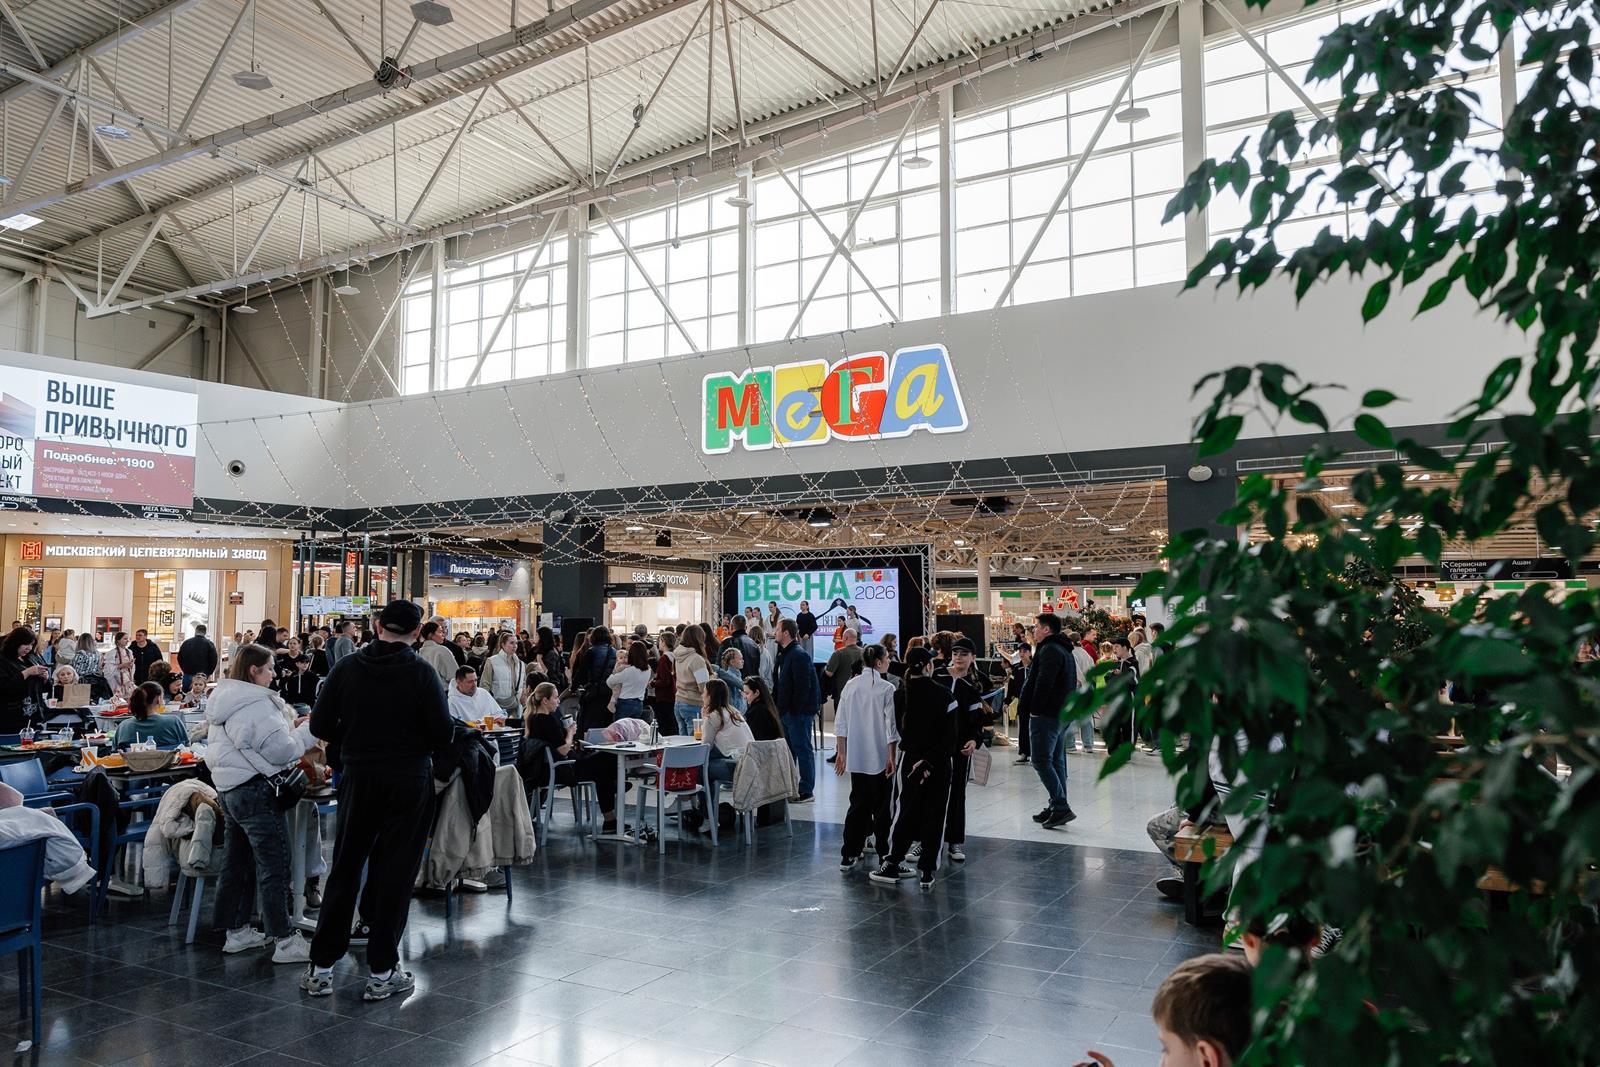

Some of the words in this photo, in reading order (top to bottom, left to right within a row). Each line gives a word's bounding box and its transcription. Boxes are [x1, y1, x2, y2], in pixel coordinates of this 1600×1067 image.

[47, 379, 115, 411] ВЫШЕ
[45, 410, 188, 449] ПРИВЫЧНОГО
[43, 449, 117, 466] Подробнее:
[46, 545, 126, 557] МОСКОВСКИЙ
[129, 547, 228, 559] ЦЕПЕВЯЗАЛЬНЫЙ
[232, 549, 267, 561] ЗАВОД
[449, 564, 495, 577] Линзмастер
[632, 572, 646, 583] 585
[656, 573, 689, 585] ЗОЛОТОЙ
[743, 572, 850, 602] ВЕСНА
[855, 585, 896, 600] 2026
